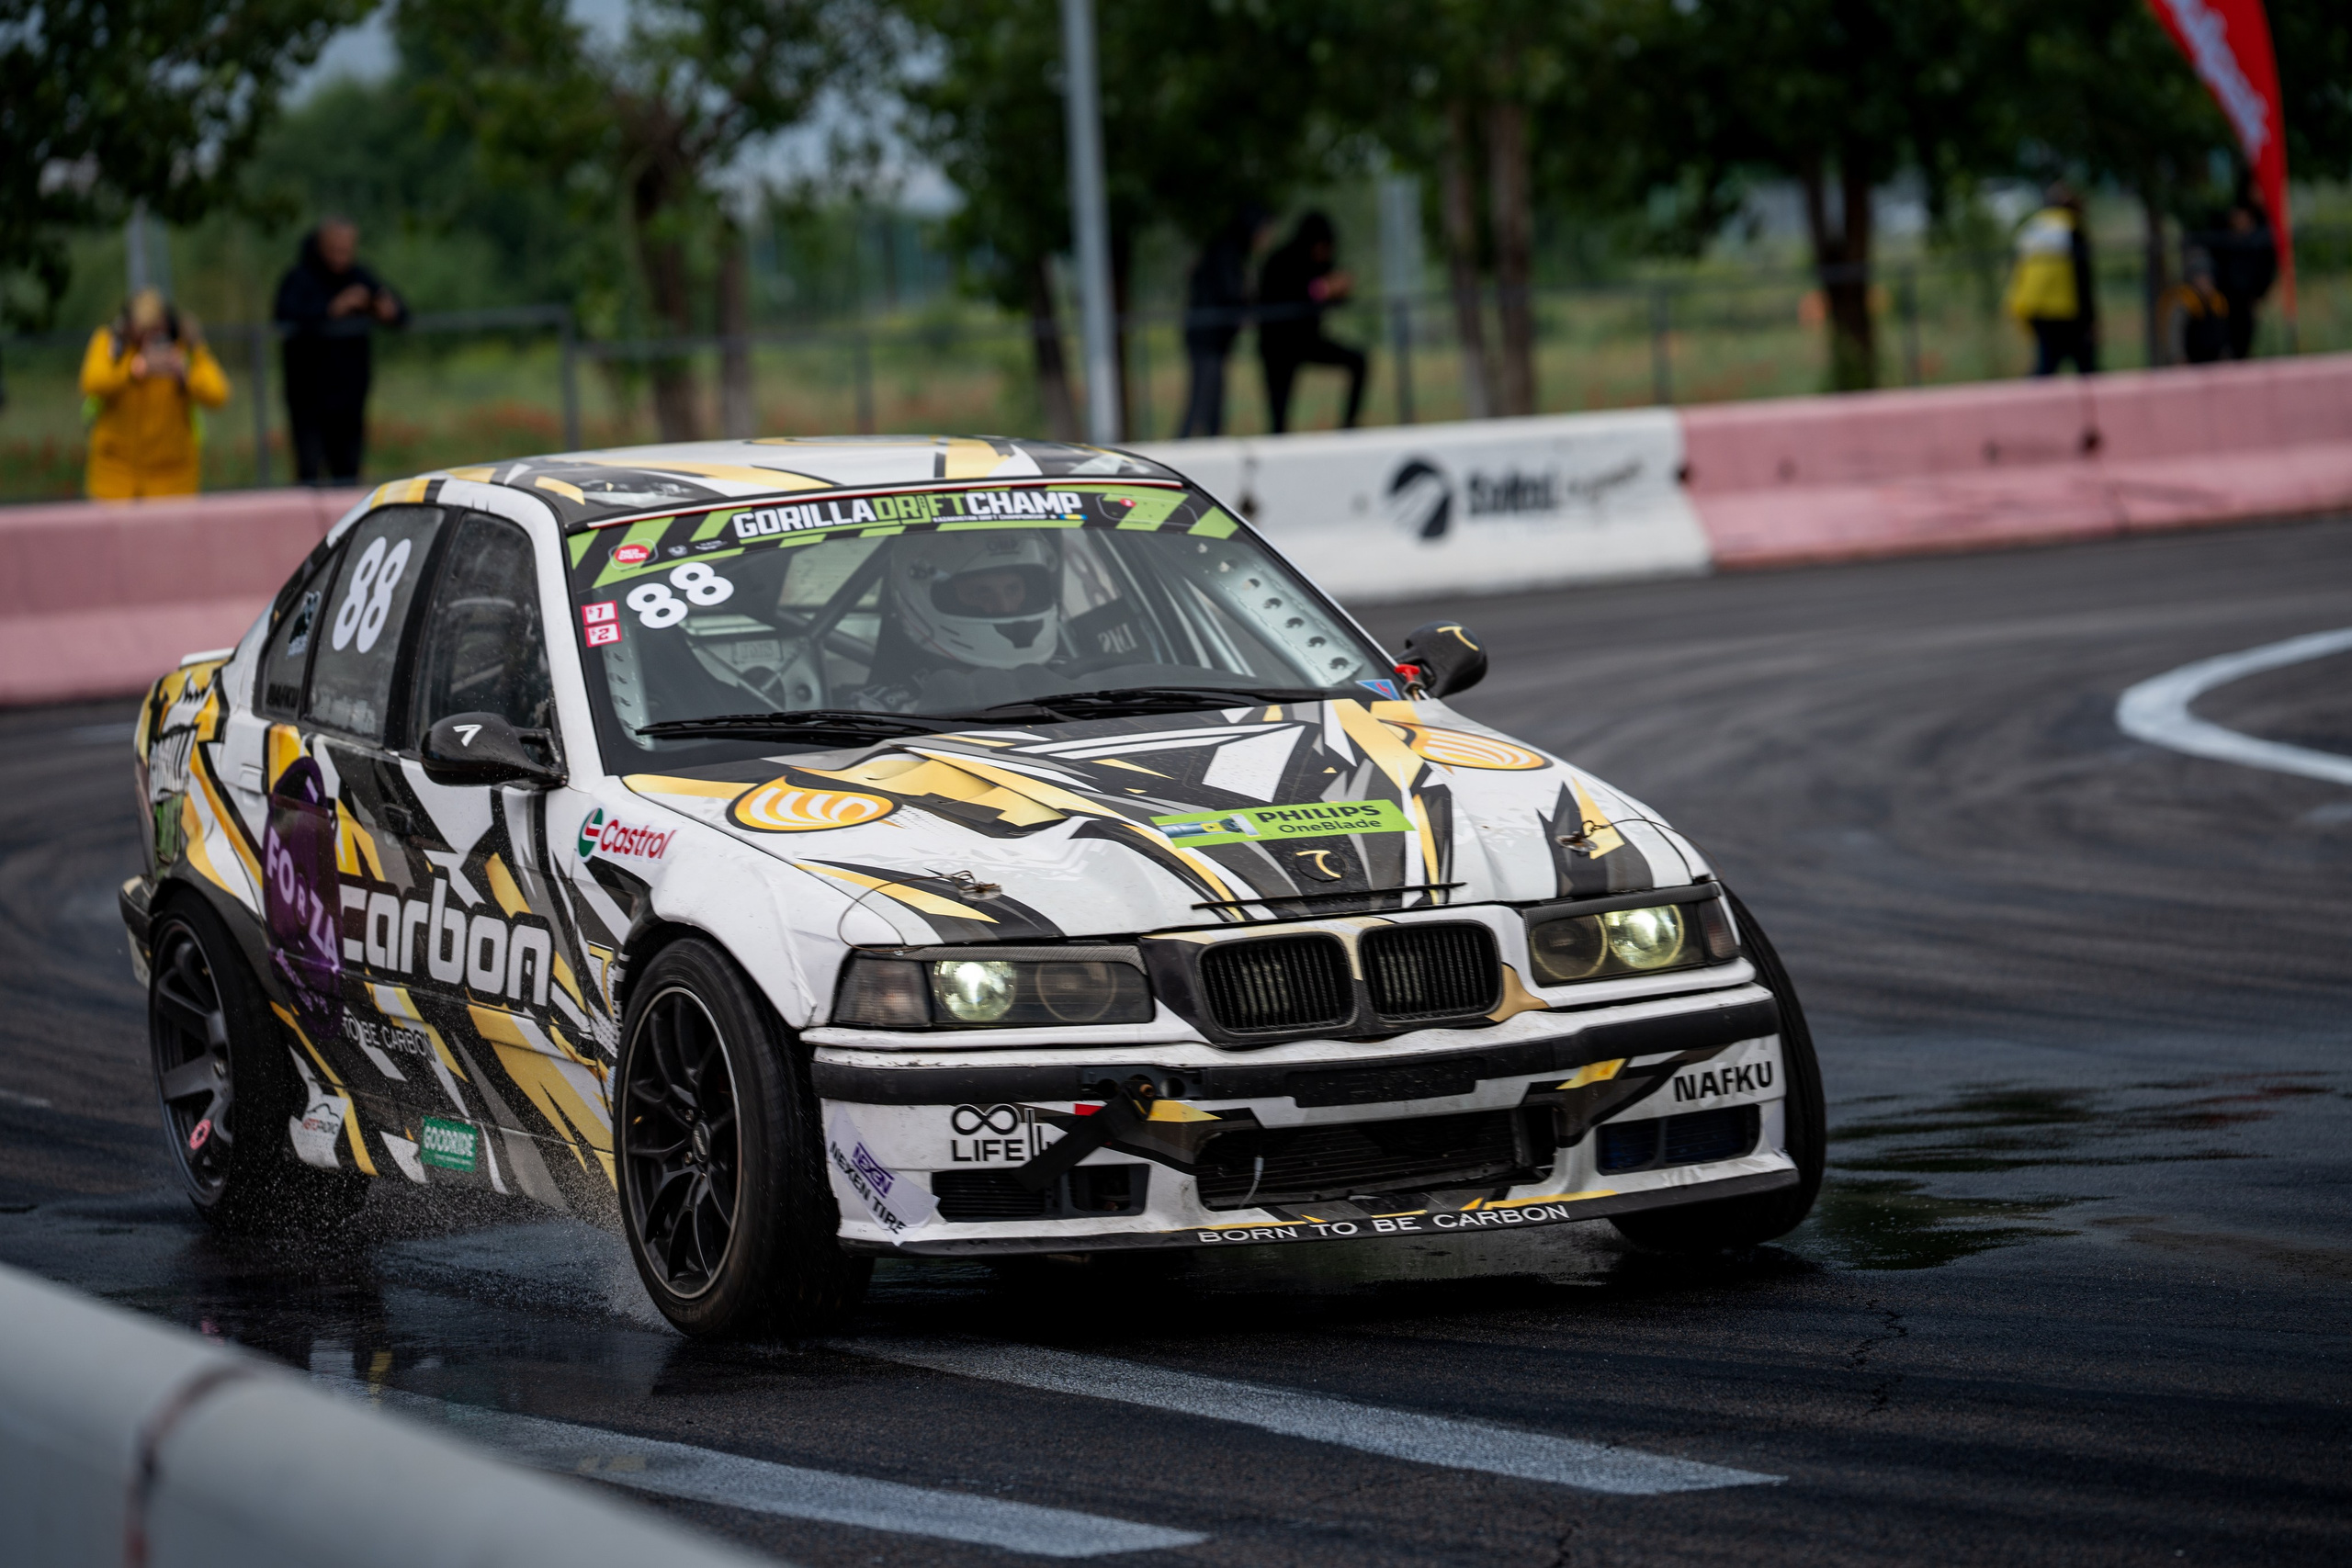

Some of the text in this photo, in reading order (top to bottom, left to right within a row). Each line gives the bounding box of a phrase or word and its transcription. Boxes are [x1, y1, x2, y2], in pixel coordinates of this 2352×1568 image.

[332, 536, 412, 654] 88
[626, 561, 734, 629] 88
[1255, 805, 1382, 823] PHILIPS
[1278, 818, 1382, 833] OneBlade
[600, 818, 677, 860] Castrol
[360, 1020, 380, 1046] BE
[381, 1024, 436, 1063] CARBON
[1674, 1060, 1773, 1102] NAFKU
[423, 1125, 475, 1157] GOODRIDE
[951, 1139, 1025, 1162] LIFE
[829, 1140, 908, 1235] NEXEN TIRE
[851, 1142, 895, 1199] NEXEN
[1198, 1204, 1571, 1244] BORN TO BE CARBON
